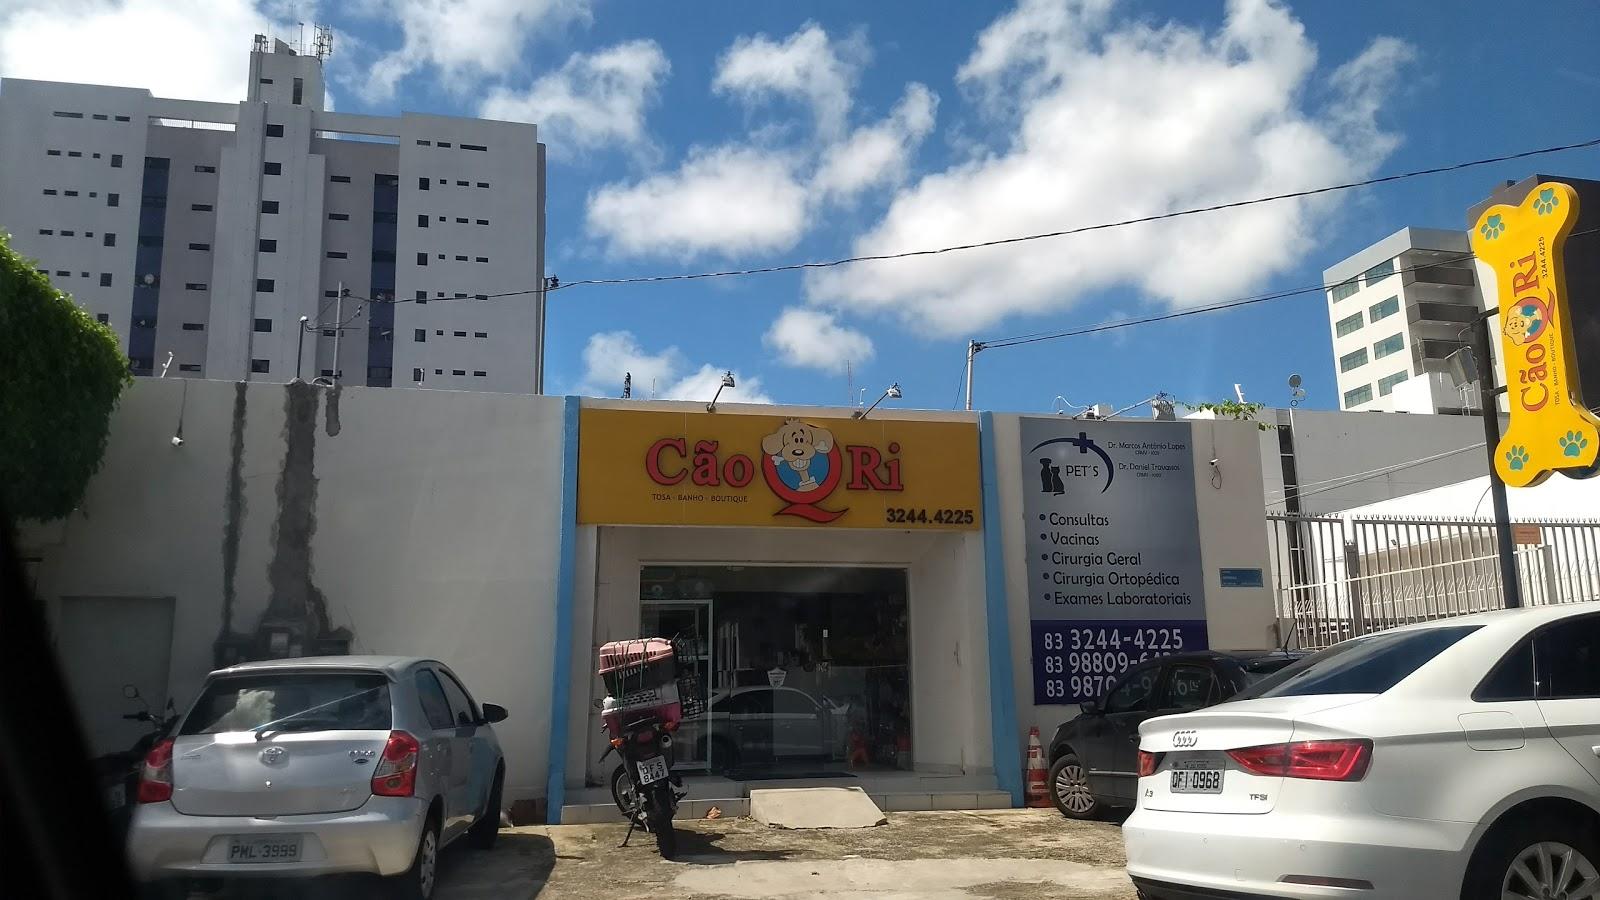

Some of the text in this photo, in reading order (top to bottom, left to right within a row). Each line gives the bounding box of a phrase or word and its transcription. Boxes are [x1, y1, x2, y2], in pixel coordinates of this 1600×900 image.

[1107, 441, 1118, 449] Dr.
[1167, 442, 1186, 451] Lopes
[1118, 462, 1129, 470] Dr.
[1129, 462, 1150, 470] Daniel
[652, 493, 748, 504] TOSA BANHO BOUTIQUE
[886, 508, 974, 525] 3244.4225
[1049, 512, 1109, 526] Consultas
[1050, 531, 1100, 545] Vacinas
[1051, 551, 1142, 567] Cirurgia Geral
[1053, 571, 1180, 588] Cirurgia Ortopédica
[1054, 591, 1192, 606] Exames Laboratoriais
[1044, 628, 1183, 650] 83 3244-4225
[1045, 656, 1063, 674] 83
[1046, 679, 1065, 697] 83
[643, 769, 665, 783] 8447
[1249, 793, 1268, 801] TFSI
